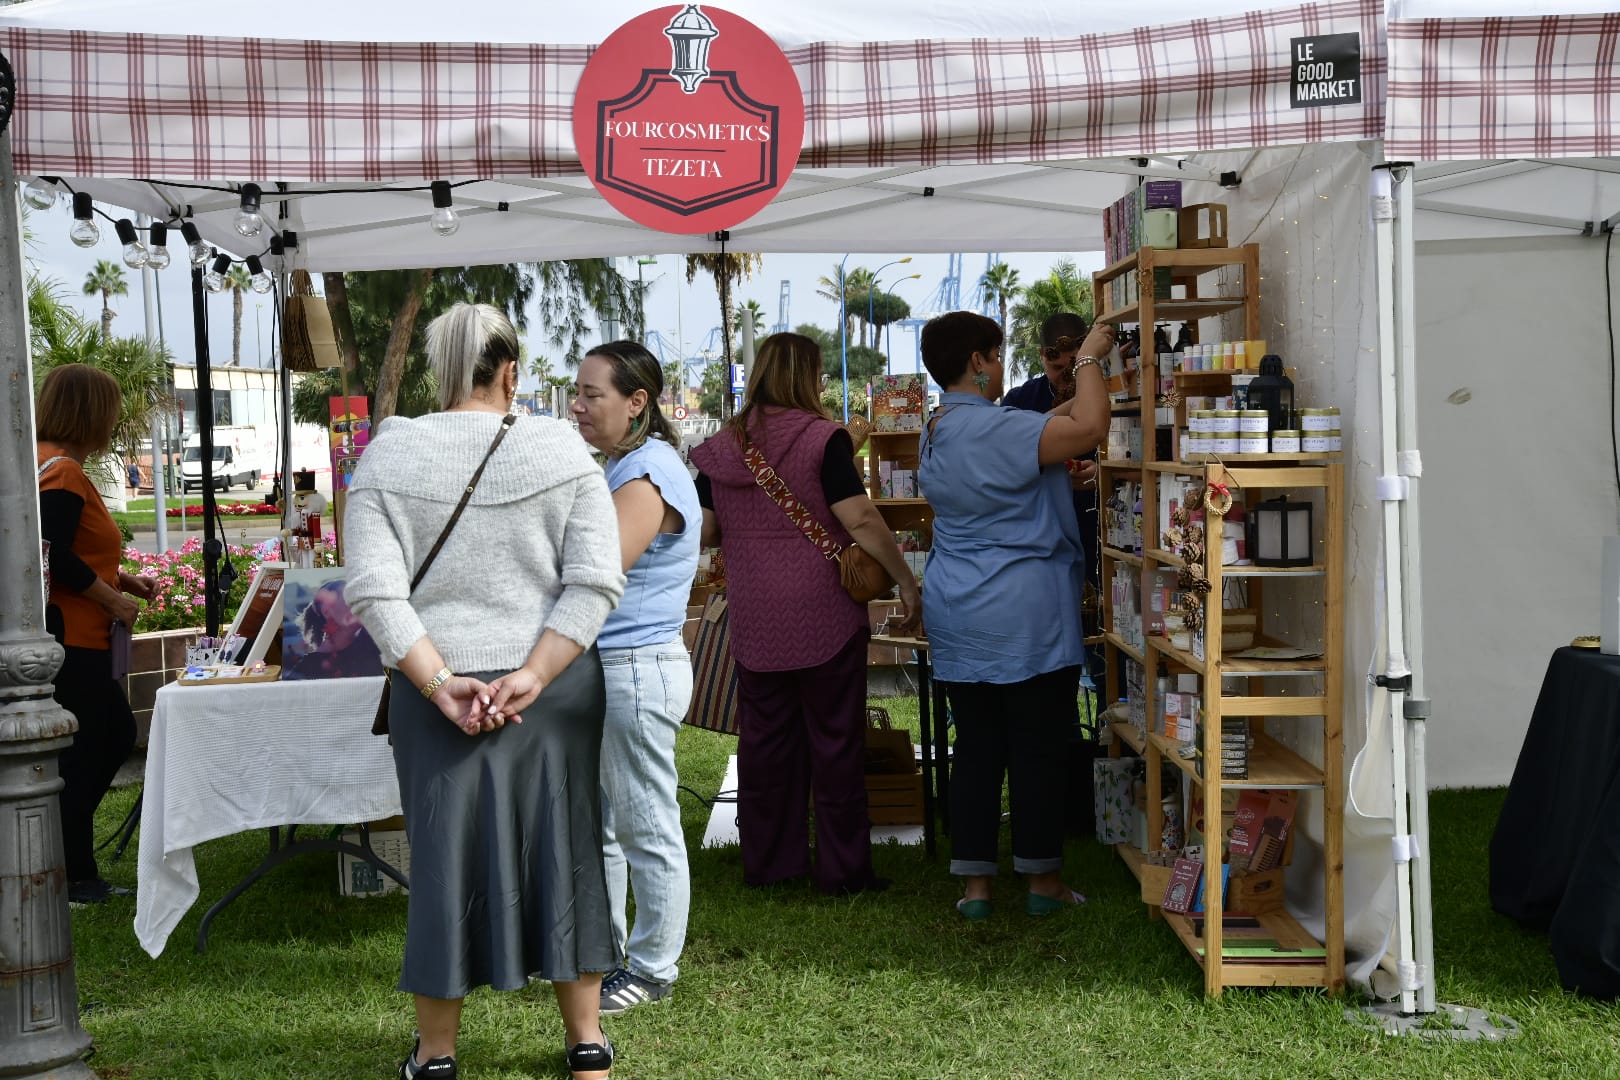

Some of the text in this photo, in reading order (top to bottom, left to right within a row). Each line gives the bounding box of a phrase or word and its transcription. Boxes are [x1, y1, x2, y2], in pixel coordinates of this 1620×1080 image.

[1297, 43, 1314, 62] LE
[1297, 62, 1334, 81] GOOD
[1296, 79, 1356, 101] MARKET
[605, 120, 770, 142] FOURCOSMETICS
[643, 158, 723, 178] TEZETA
